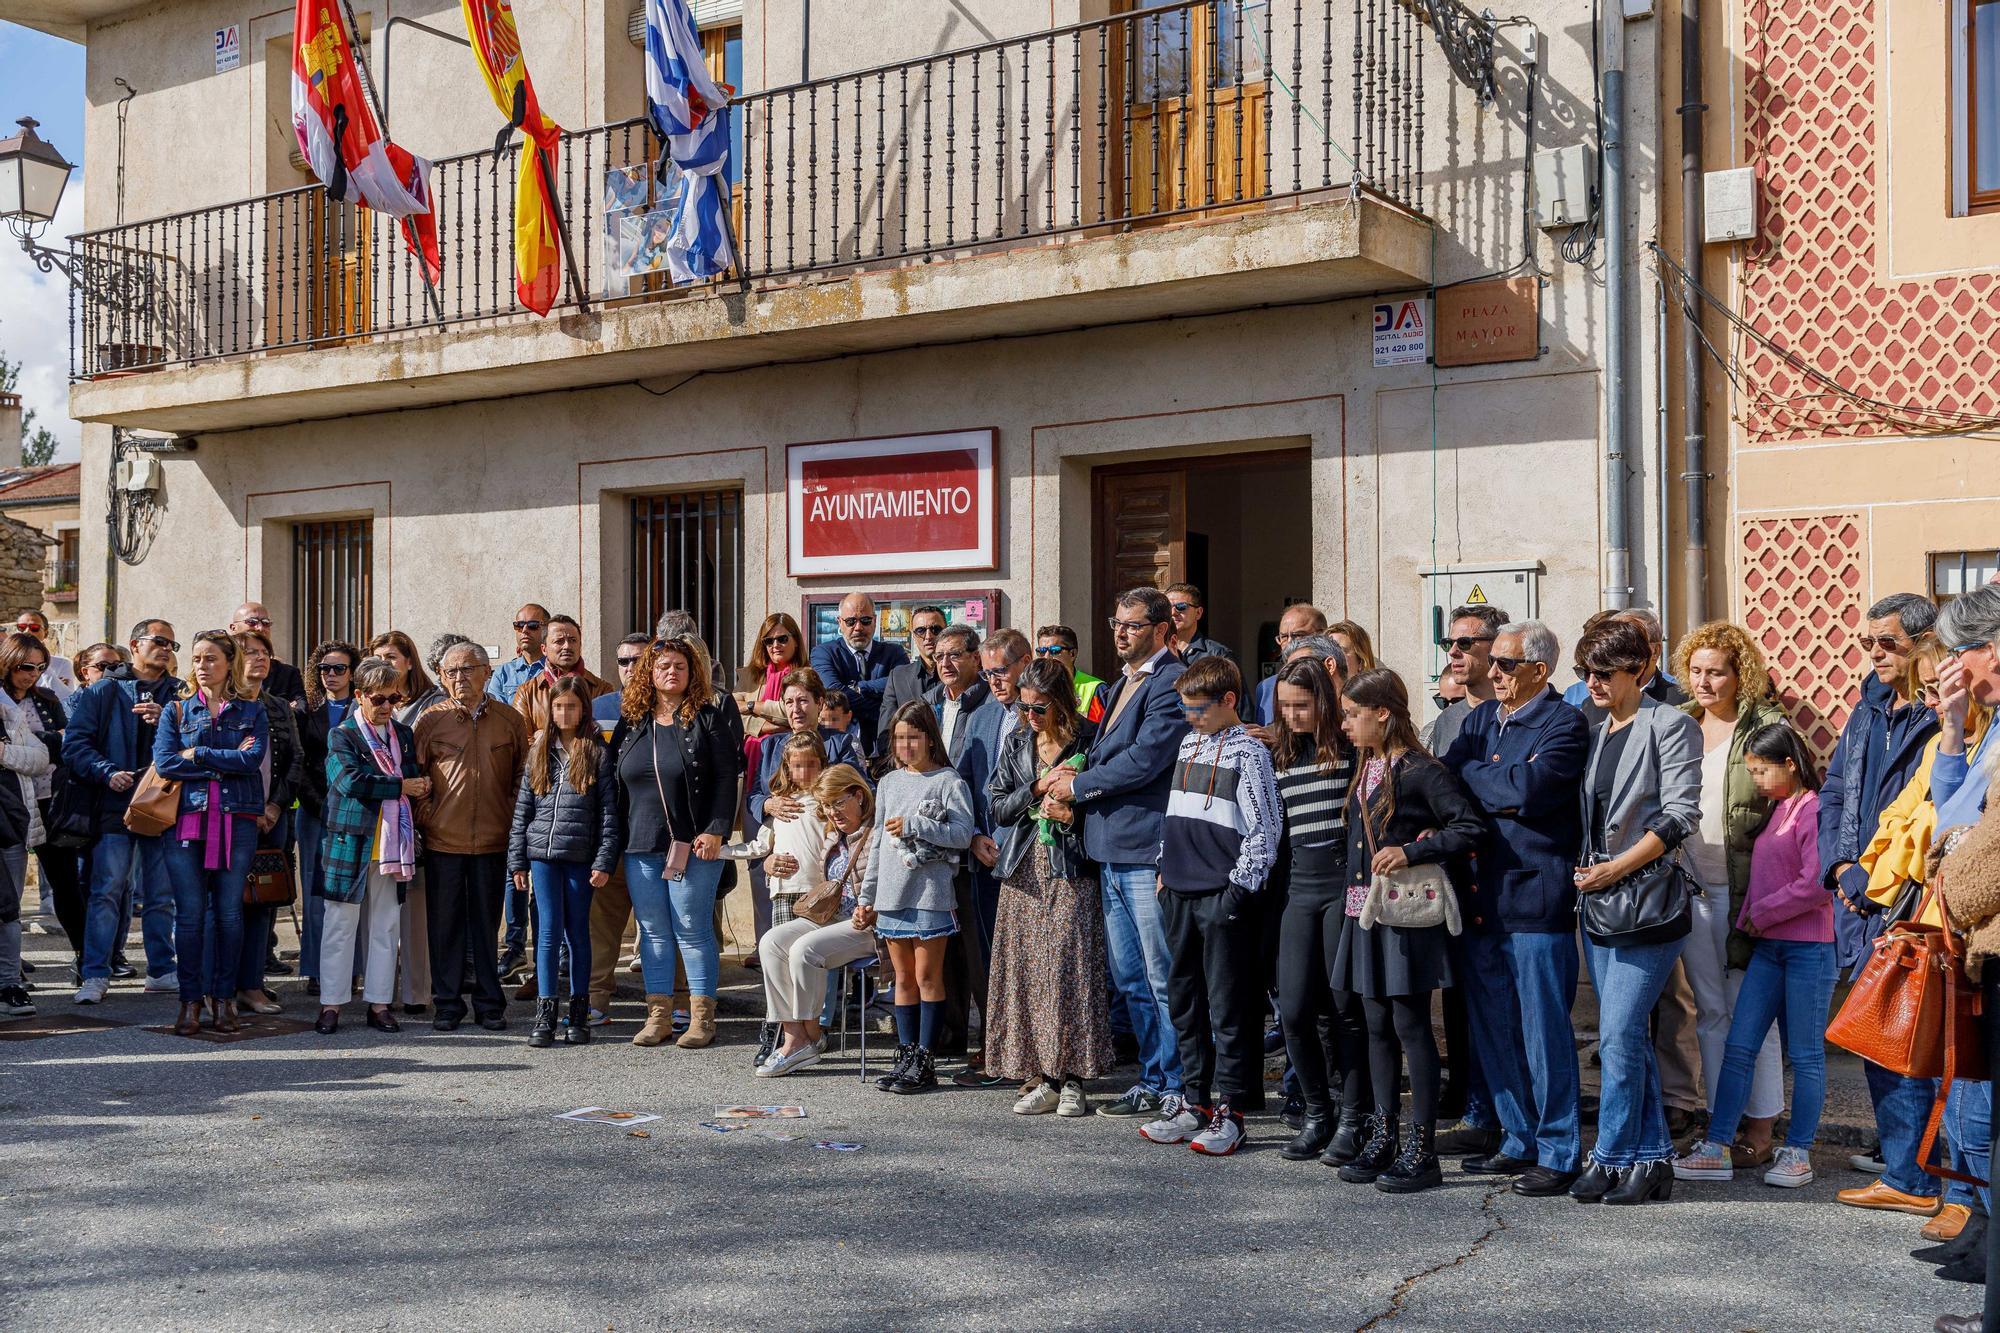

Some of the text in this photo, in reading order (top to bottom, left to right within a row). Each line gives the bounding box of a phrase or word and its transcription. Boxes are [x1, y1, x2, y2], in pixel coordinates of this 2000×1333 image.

[1463, 305, 1509, 318] PLAZA
[1375, 333, 1401, 341] DIGITAL
[1457, 326, 1515, 340] MAYOR
[1375, 342, 1424, 354] 921 420 800
[810, 486, 971, 522] AYUNTAMIENTO
